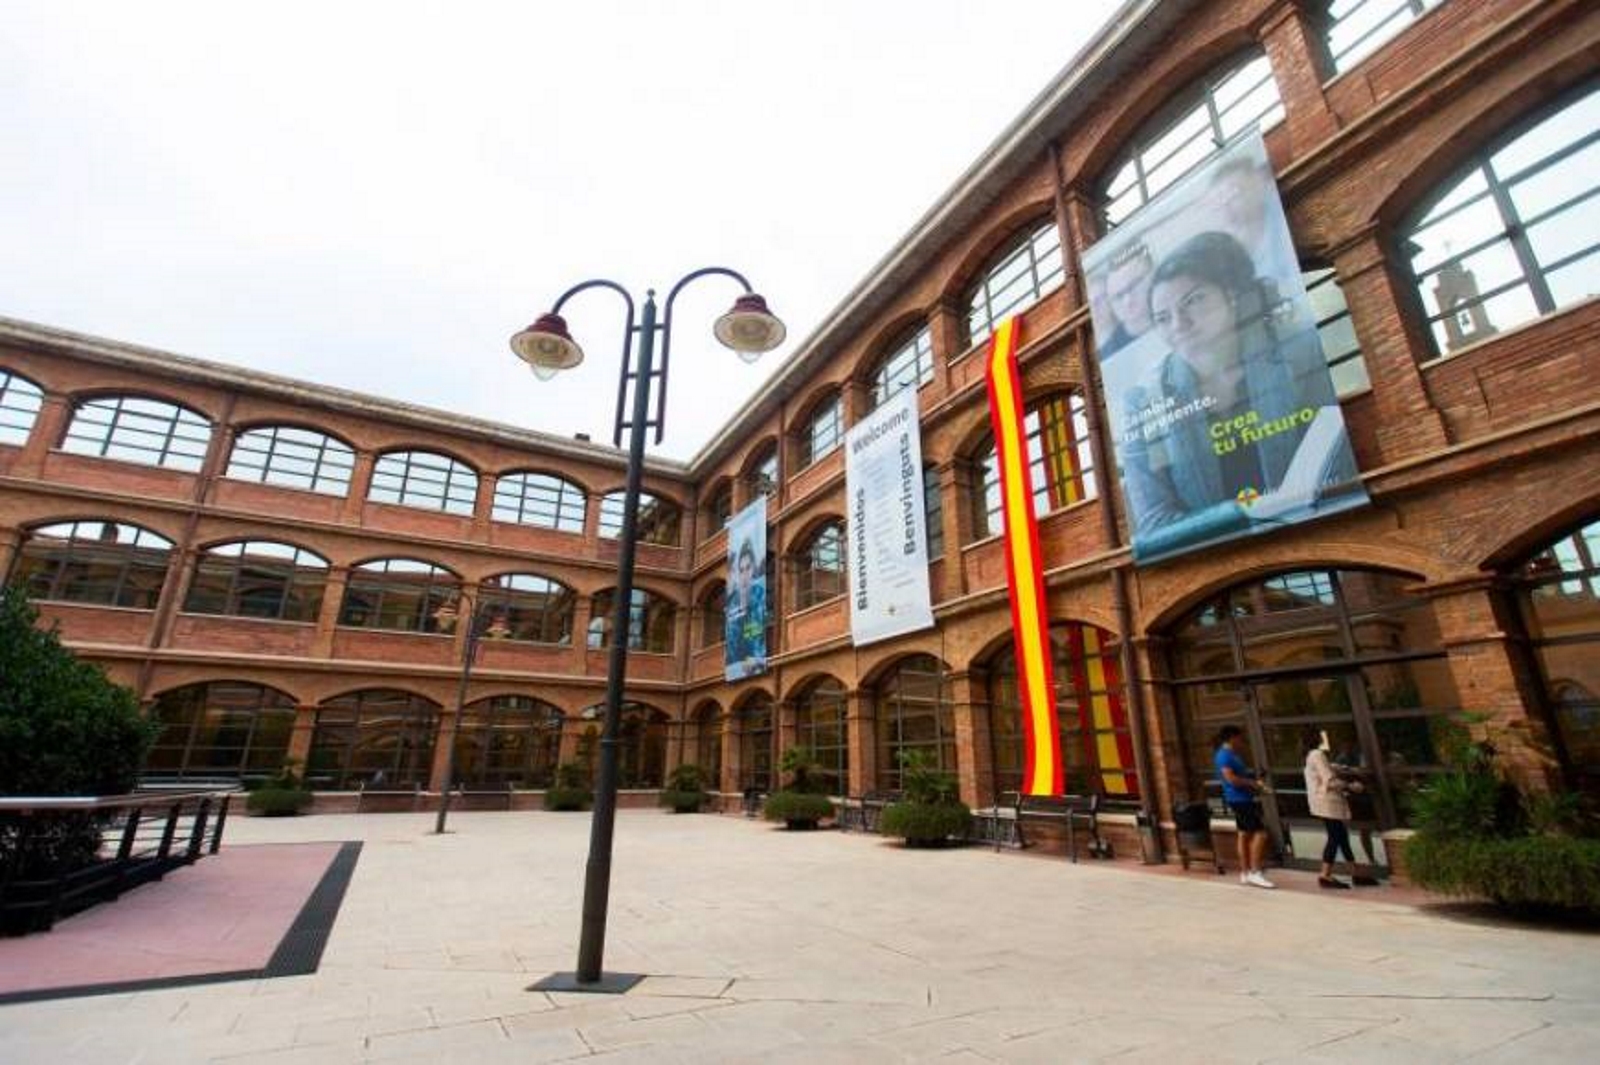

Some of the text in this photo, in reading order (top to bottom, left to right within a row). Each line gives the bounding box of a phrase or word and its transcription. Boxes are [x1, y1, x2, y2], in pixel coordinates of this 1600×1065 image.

[853, 408, 909, 454] Welcome
[1210, 411, 1259, 439] Crea
[1213, 438, 1237, 456] tu
[900, 432, 917, 556] Benvinguts
[855, 487, 868, 611] Bienvenidos
